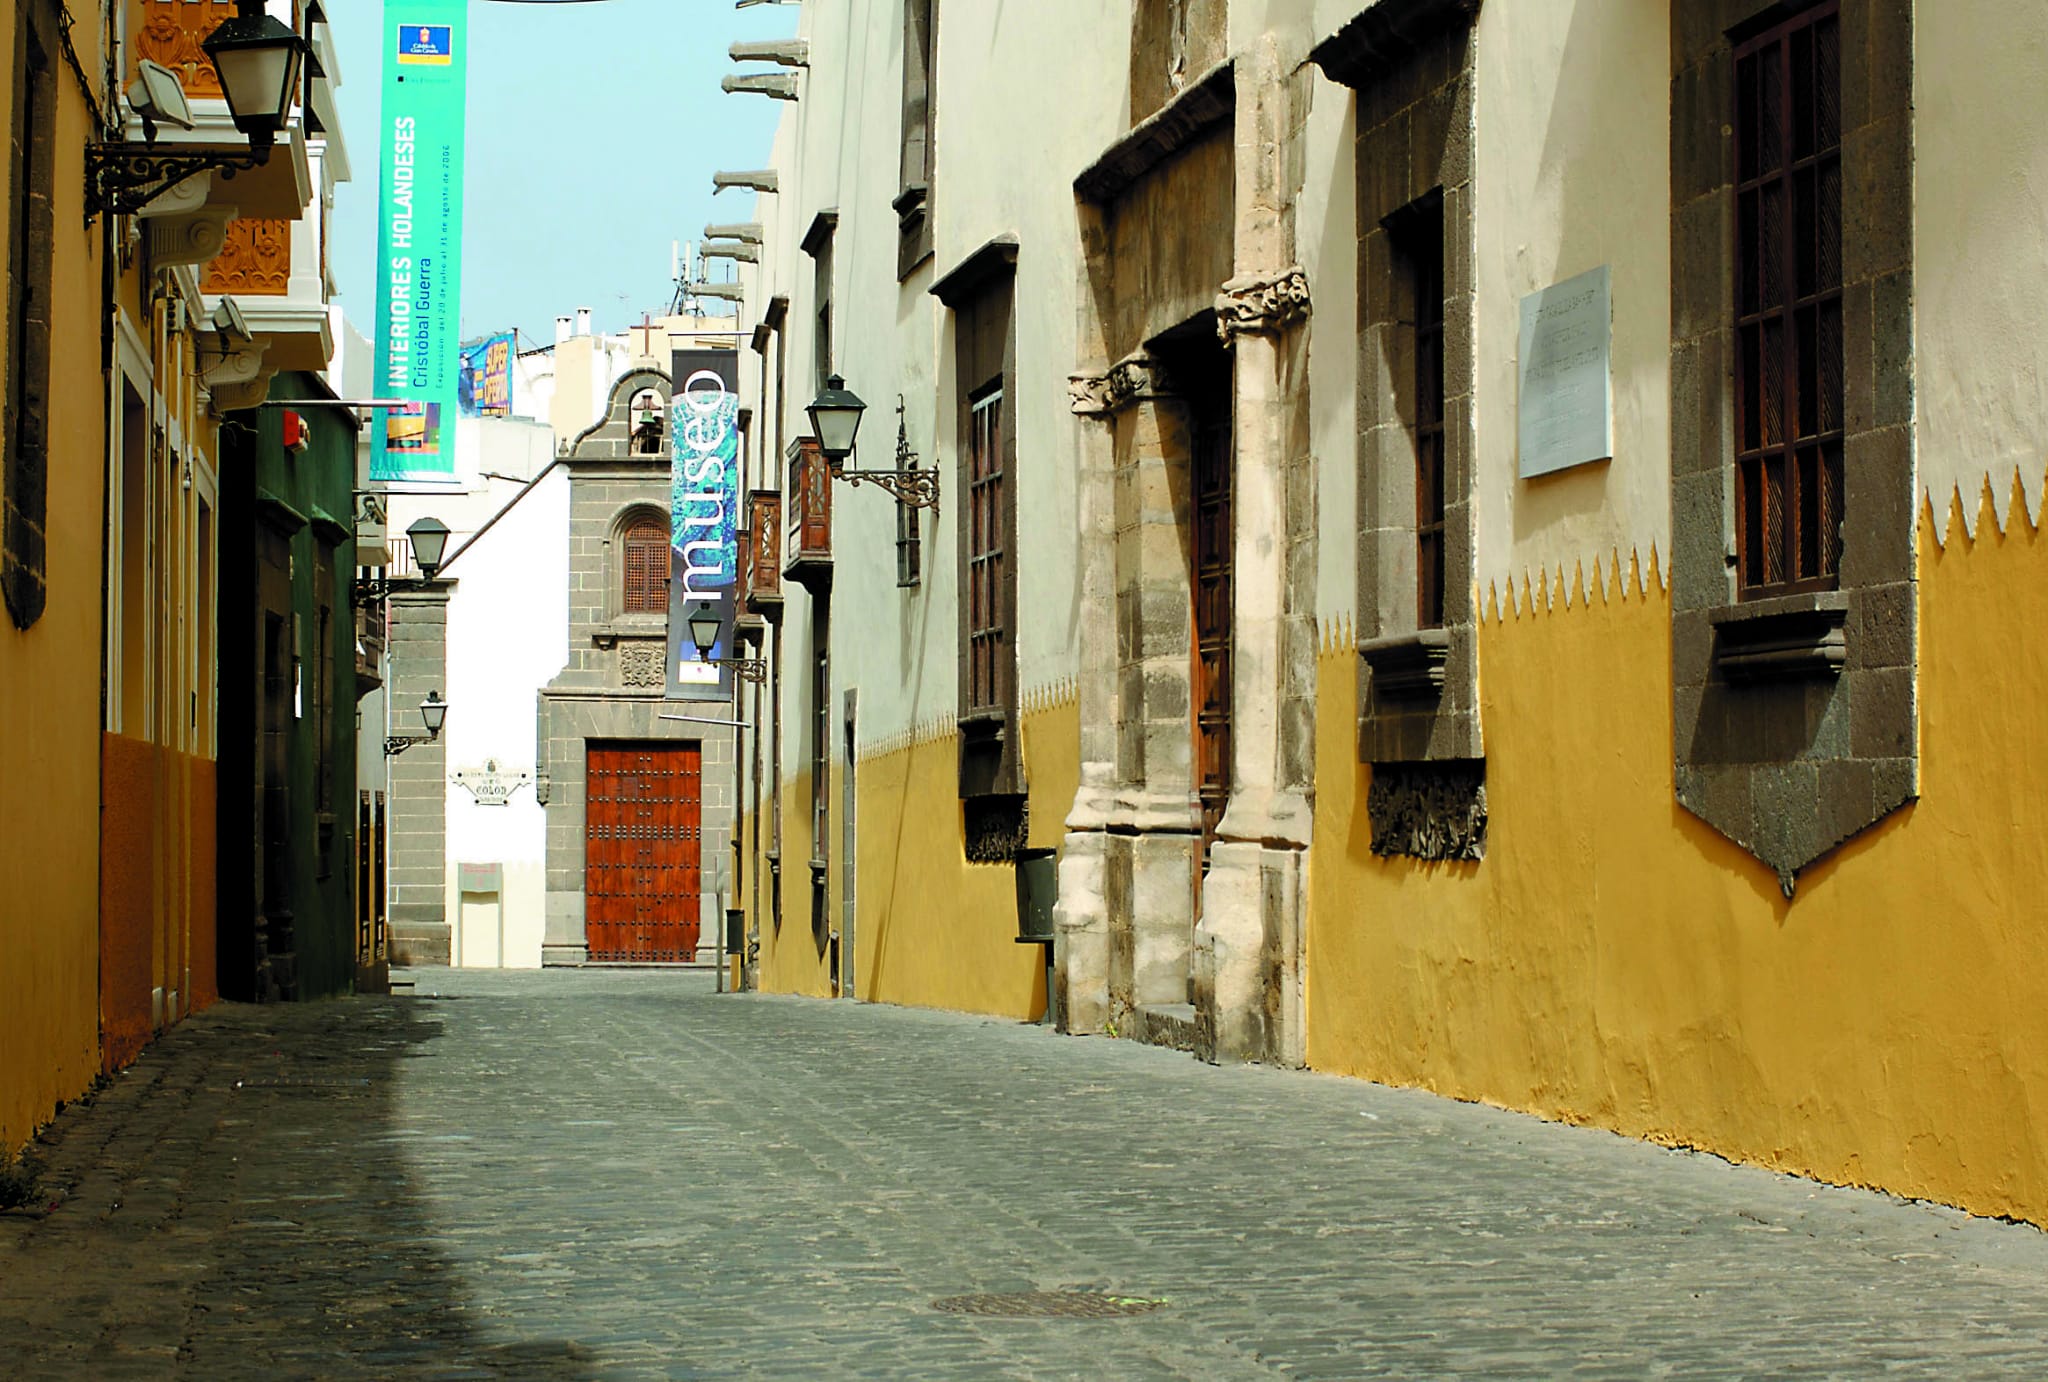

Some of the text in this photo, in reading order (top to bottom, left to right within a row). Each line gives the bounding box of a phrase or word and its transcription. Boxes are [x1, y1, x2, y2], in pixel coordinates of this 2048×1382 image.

[442, 145, 450, 168] 2006
[442, 173, 449, 184] de
[441, 187, 450, 217] agosto
[440, 222, 448, 233] de
[388, 116, 416, 388] INTERIORES HOLANDESES
[440, 251, 447, 260] al
[438, 264, 448, 285] julio
[438, 288, 446, 298] de
[438, 302, 446, 313] 20
[413, 258, 432, 388] Cristóbal Guerra
[437, 317, 445, 331] del
[436, 338, 445, 389] Exposición
[682, 369, 726, 605] museo
